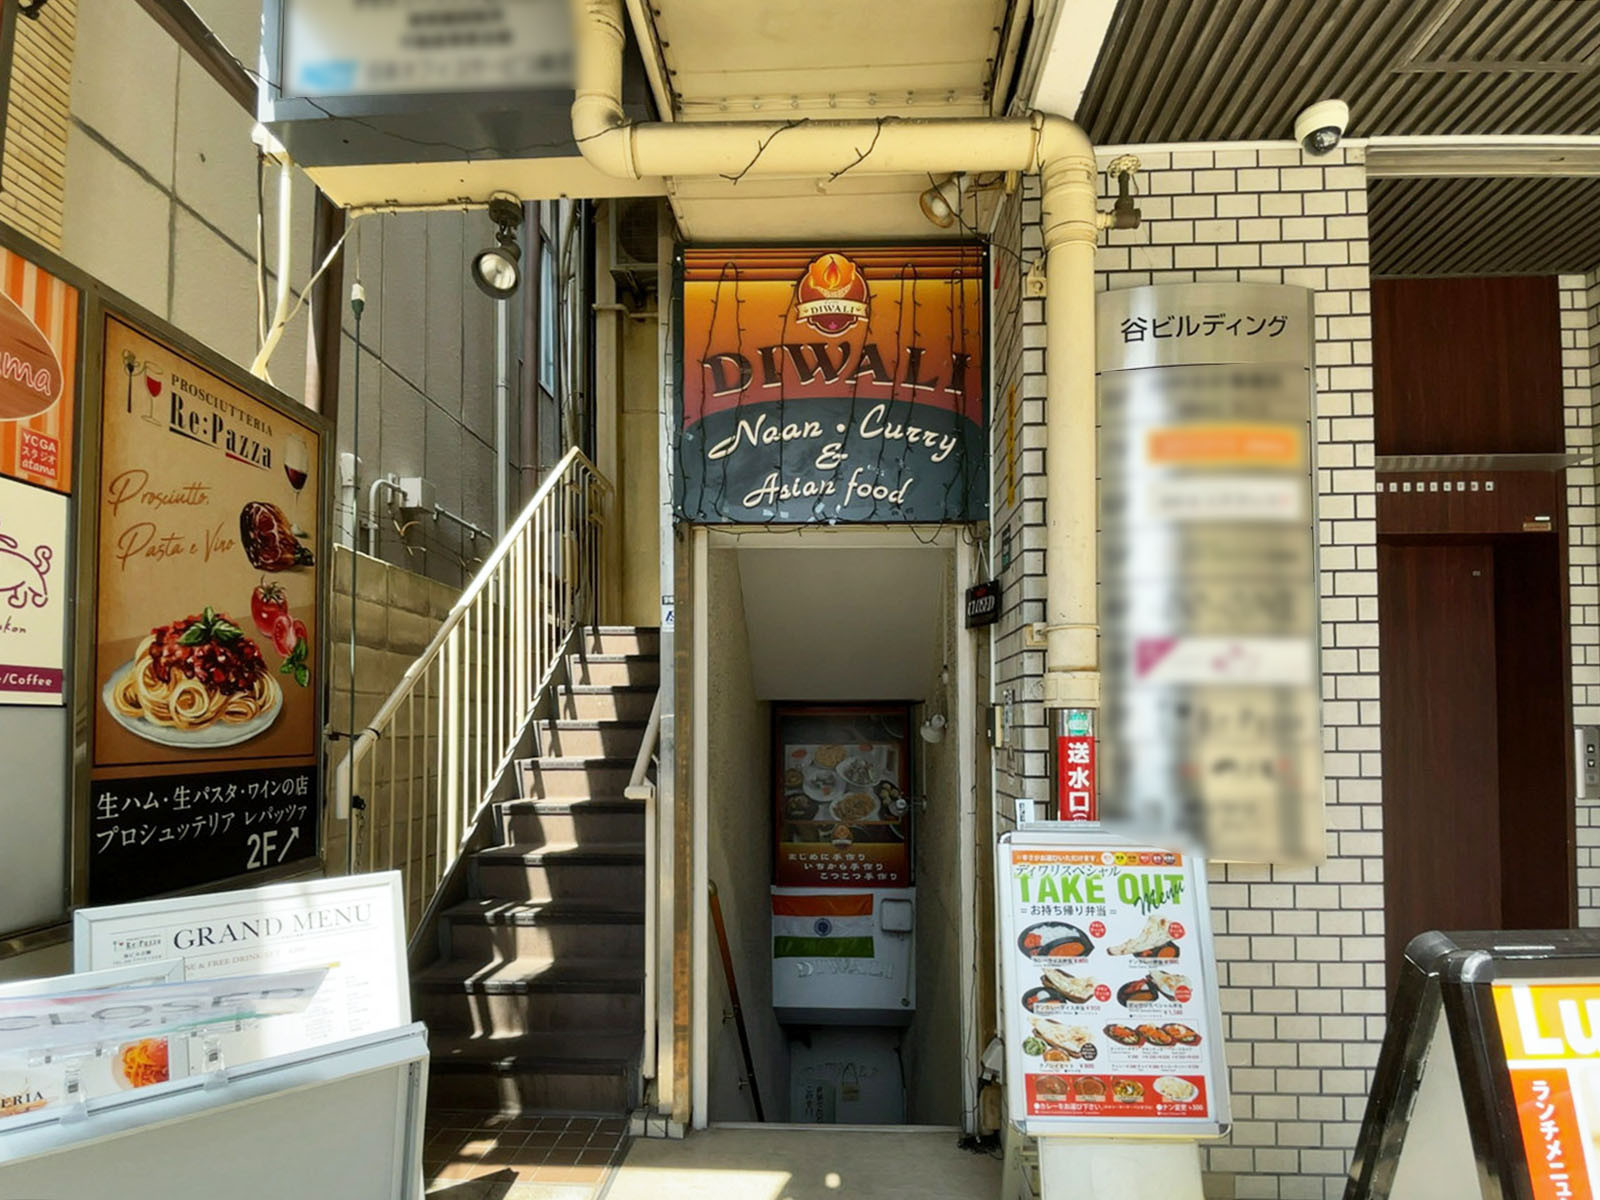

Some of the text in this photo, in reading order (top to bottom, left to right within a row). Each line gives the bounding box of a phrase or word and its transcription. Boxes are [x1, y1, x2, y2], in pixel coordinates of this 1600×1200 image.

[810, 304, 855, 315] DIWALI
[1121, 313, 1288, 343] 谷ビルディング
[0, 352, 51, 396] ma
[703, 342, 971, 396] DIWALI
[171, 374, 273, 437] PROSCIUTTERIA
[169, 393, 272, 469] Re:Pazza
[708, 414, 822, 460] Naan
[859, 404, 957, 463] Curry
[22, 446, 56, 465] スタジオ
[22, 460, 56, 477] atama
[815, 443, 848, 470] &
[743, 467, 913, 507] Asian food
[116, 520, 236, 571] Pasta e Vino
[97, 812, 236, 854] プロシュッテリア
[247, 830, 278, 869] 2F
[820, 872, 897, 880] こつこつ手作り
[1014, 873, 1184, 905] TAKE OUT
[1016, 865, 1121, 876] ディワリスペシャル
[1133, 881, 1185, 916] Menu
[174, 904, 372, 950] GRAND MENU
[1532, 1080, 1573, 1200] ランチメニュ
